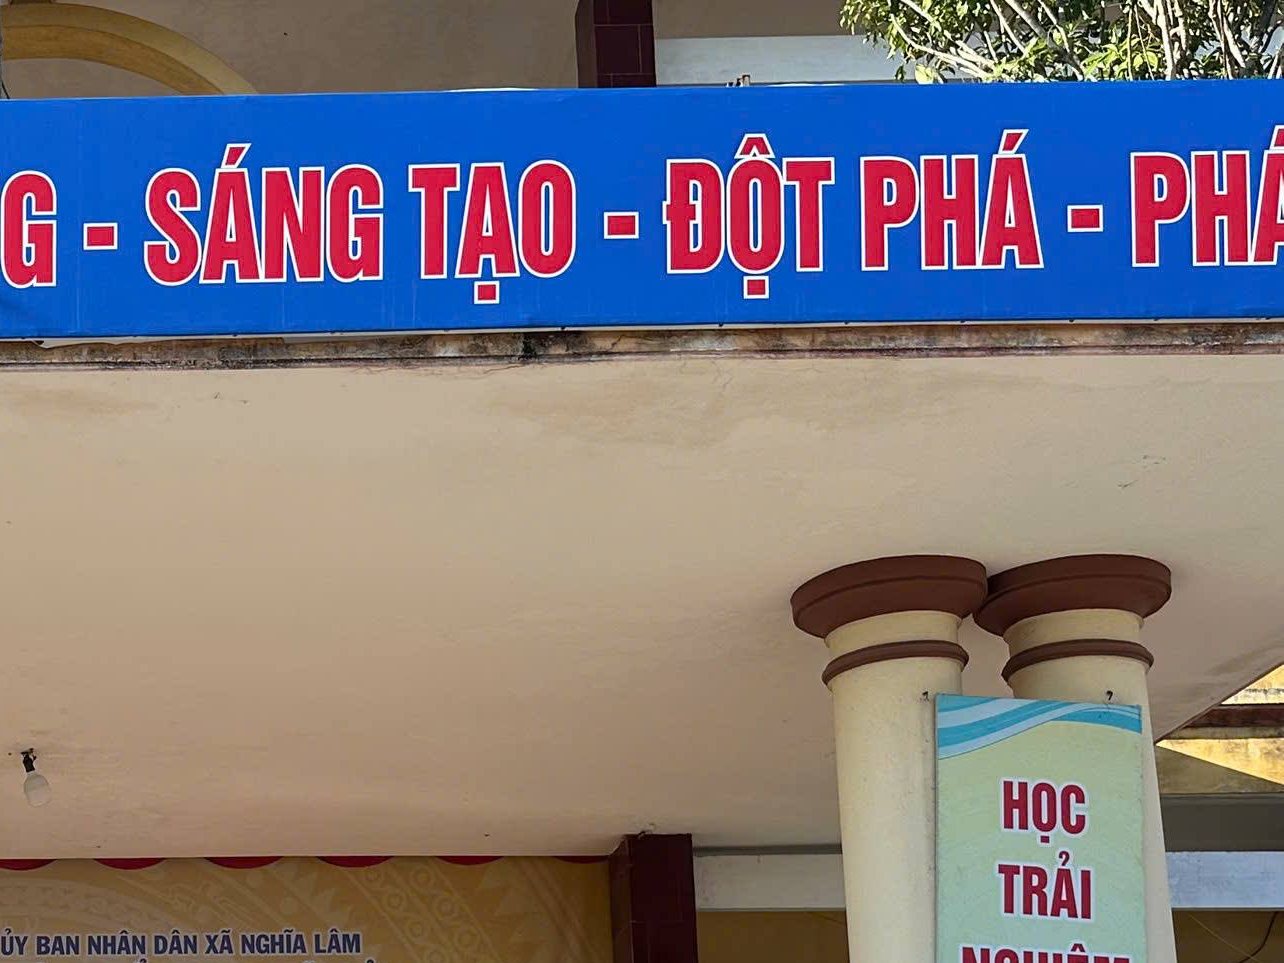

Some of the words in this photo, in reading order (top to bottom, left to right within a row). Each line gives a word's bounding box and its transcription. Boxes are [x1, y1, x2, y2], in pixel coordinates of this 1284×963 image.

[83, 222, 118, 251] -
[142, 142, 384, 288] SÁNG
[408, 158, 577, 305] TẠO
[603, 211, 639, 240] -
[662, 132, 835, 300] ĐỘT
[859, 128, 1044, 271] PHÁ
[1067, 205, 1105, 233] -
[1002, 780, 1086, 844] HỌC
[998, 851, 1093, 921] TRẢI
[0, 928, 31, 956] ỦY
[36, 935, 84, 956] BAN
[87, 929, 146, 956] NHÂN
[153, 929, 198, 955] DÂN
[205, 929, 234, 955] XÃ
[240, 928, 306, 955] NGHĨA
[313, 928, 361, 954] LÂM
